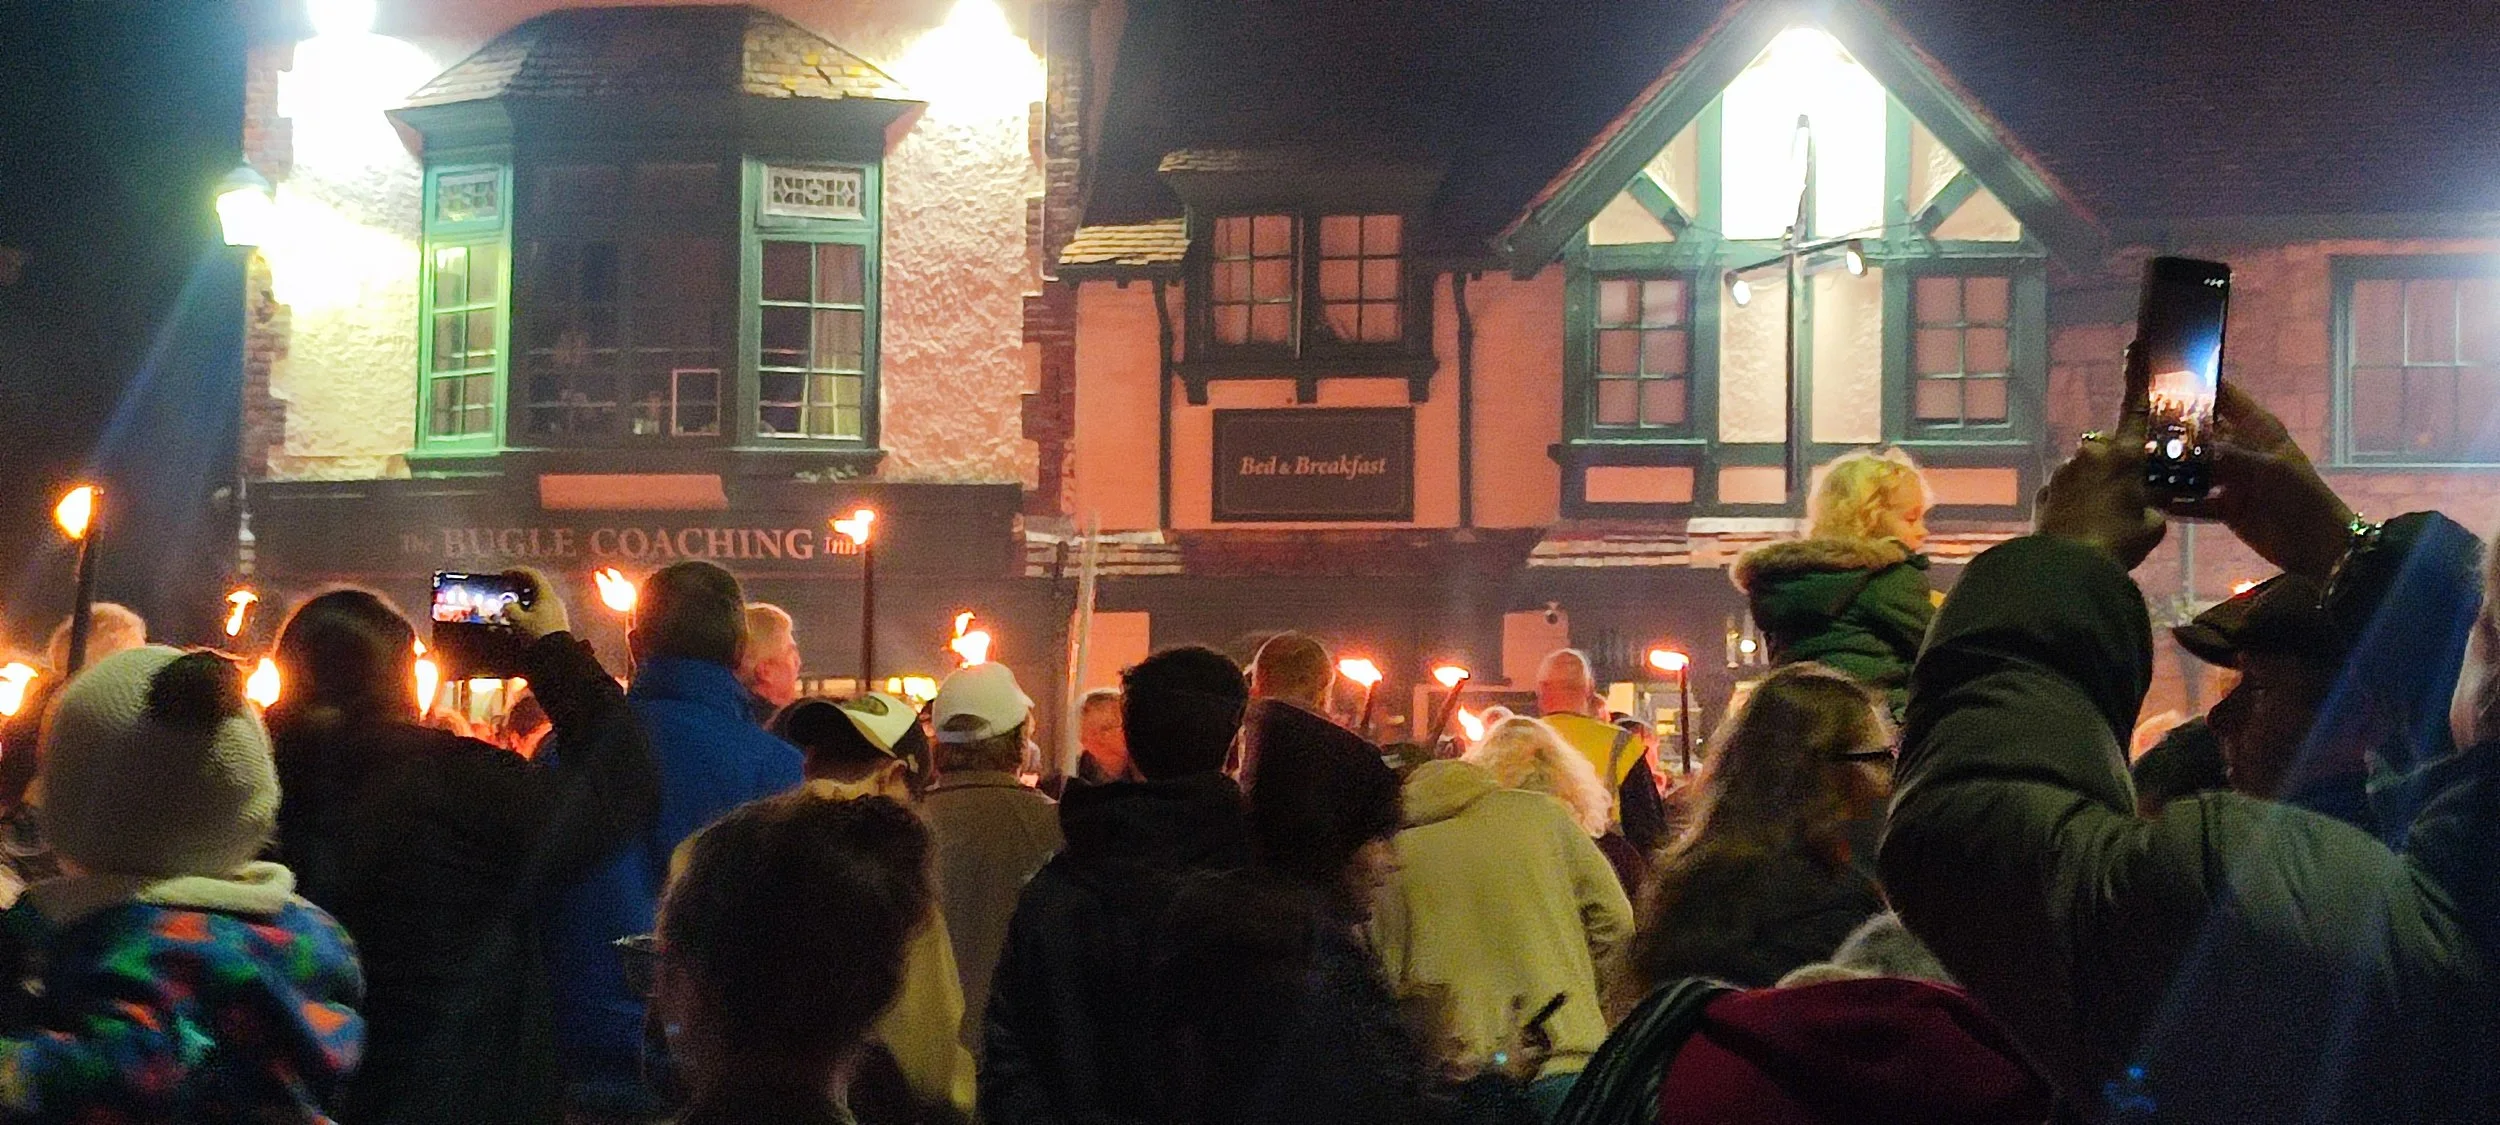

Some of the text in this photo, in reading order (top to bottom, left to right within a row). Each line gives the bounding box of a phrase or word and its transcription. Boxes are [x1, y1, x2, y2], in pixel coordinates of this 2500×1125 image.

[1240, 455, 1386, 480] Bed & Breakfast
[443, 528, 577, 558] BUGLE
[590, 528, 814, 560] COACHING
